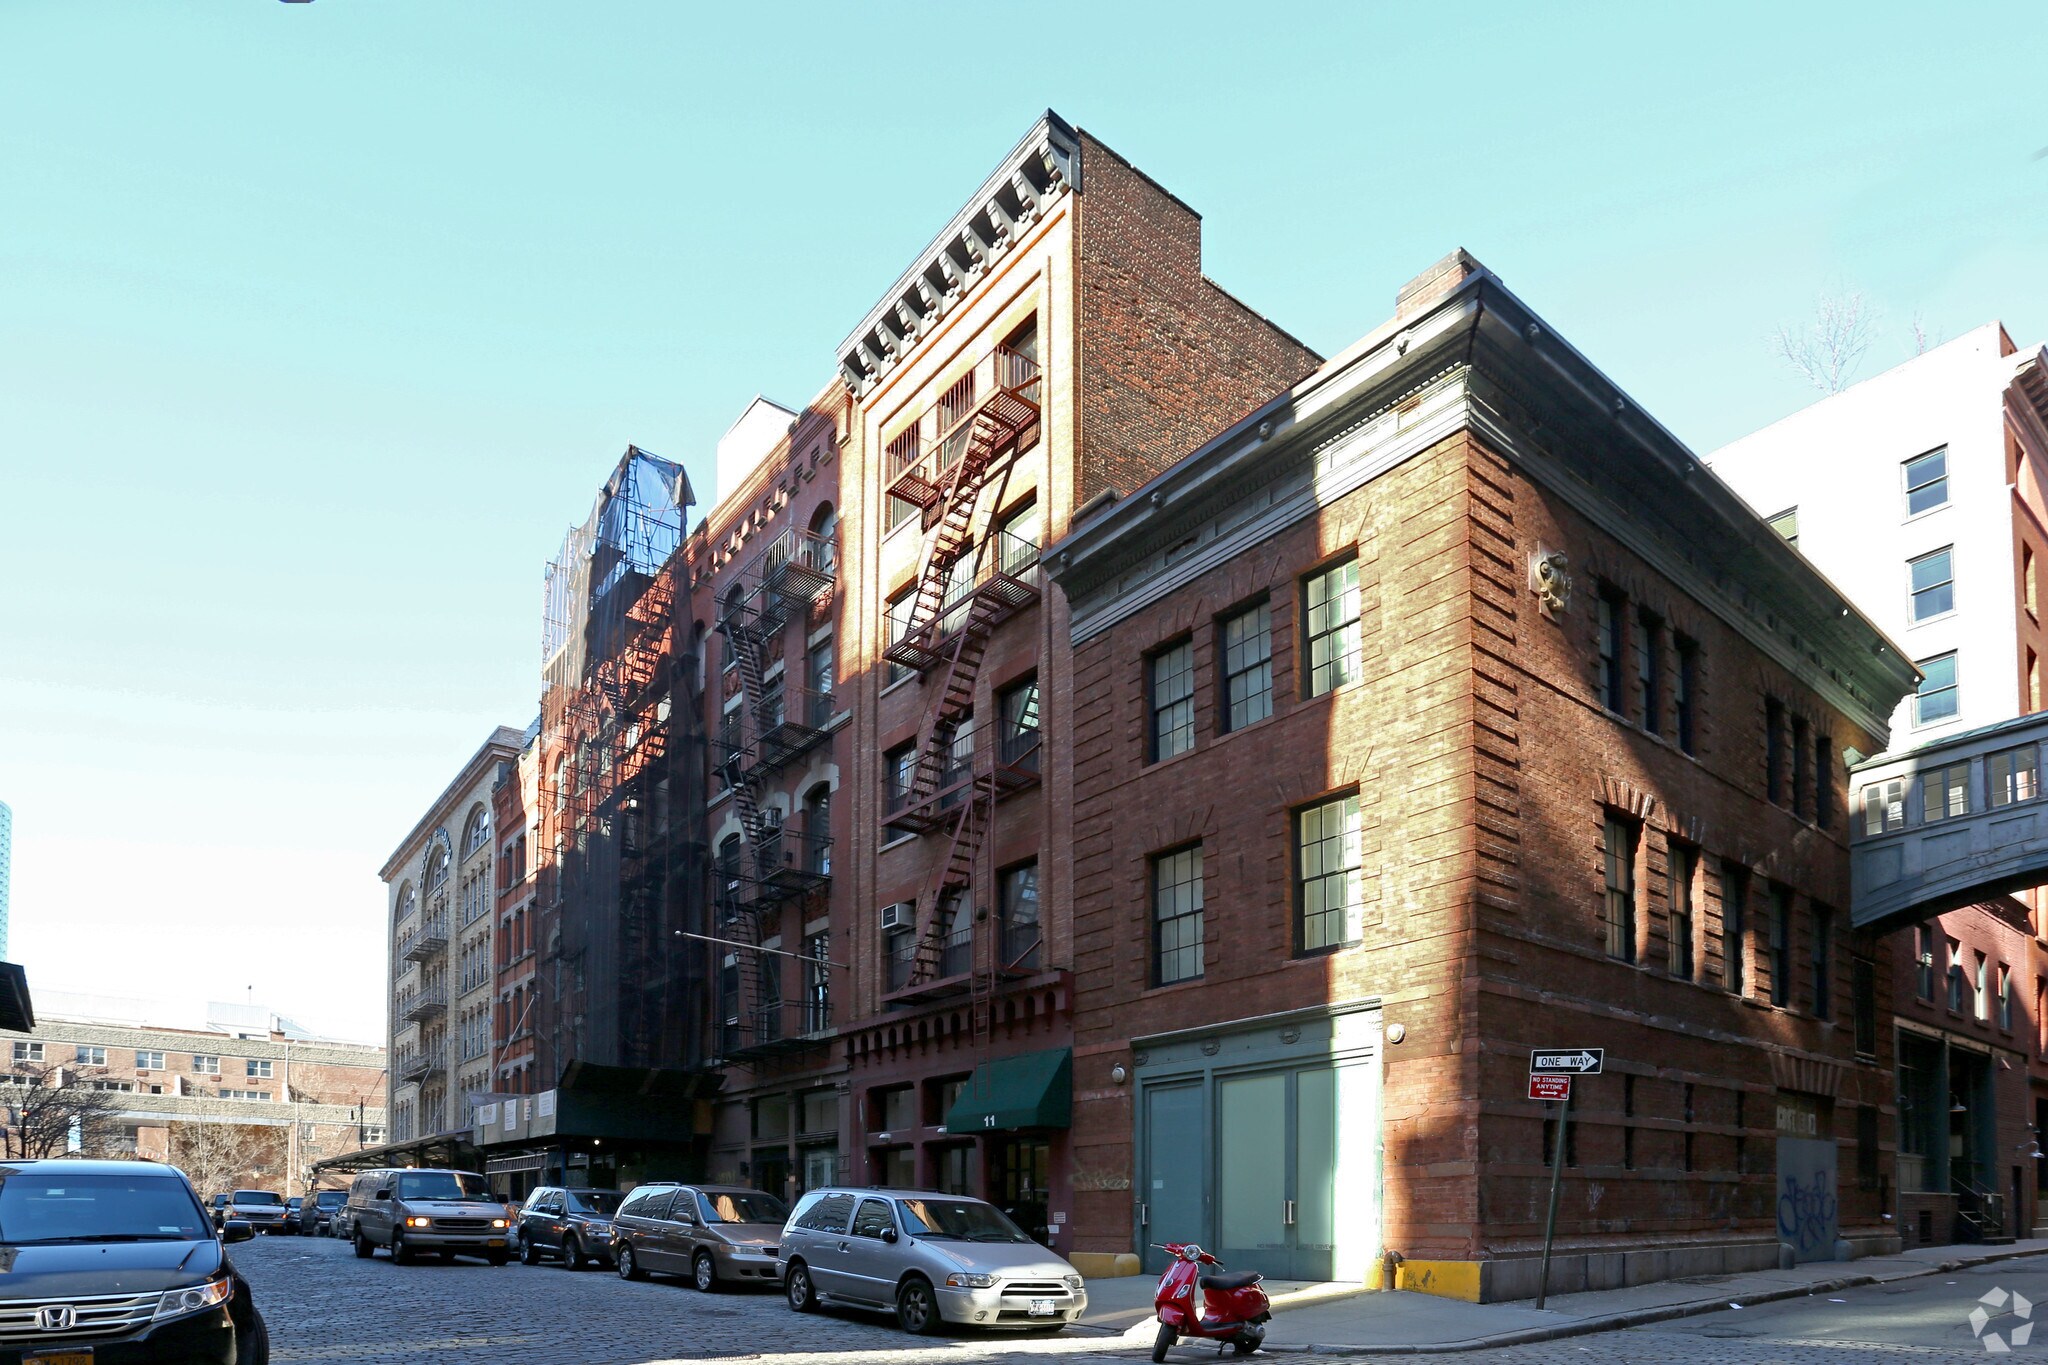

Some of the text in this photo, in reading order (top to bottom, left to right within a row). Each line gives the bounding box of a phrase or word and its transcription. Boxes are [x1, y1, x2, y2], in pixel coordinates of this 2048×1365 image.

[1541, 1057, 1592, 1066] ONE WAY
[983, 1115, 995, 1127] 11
